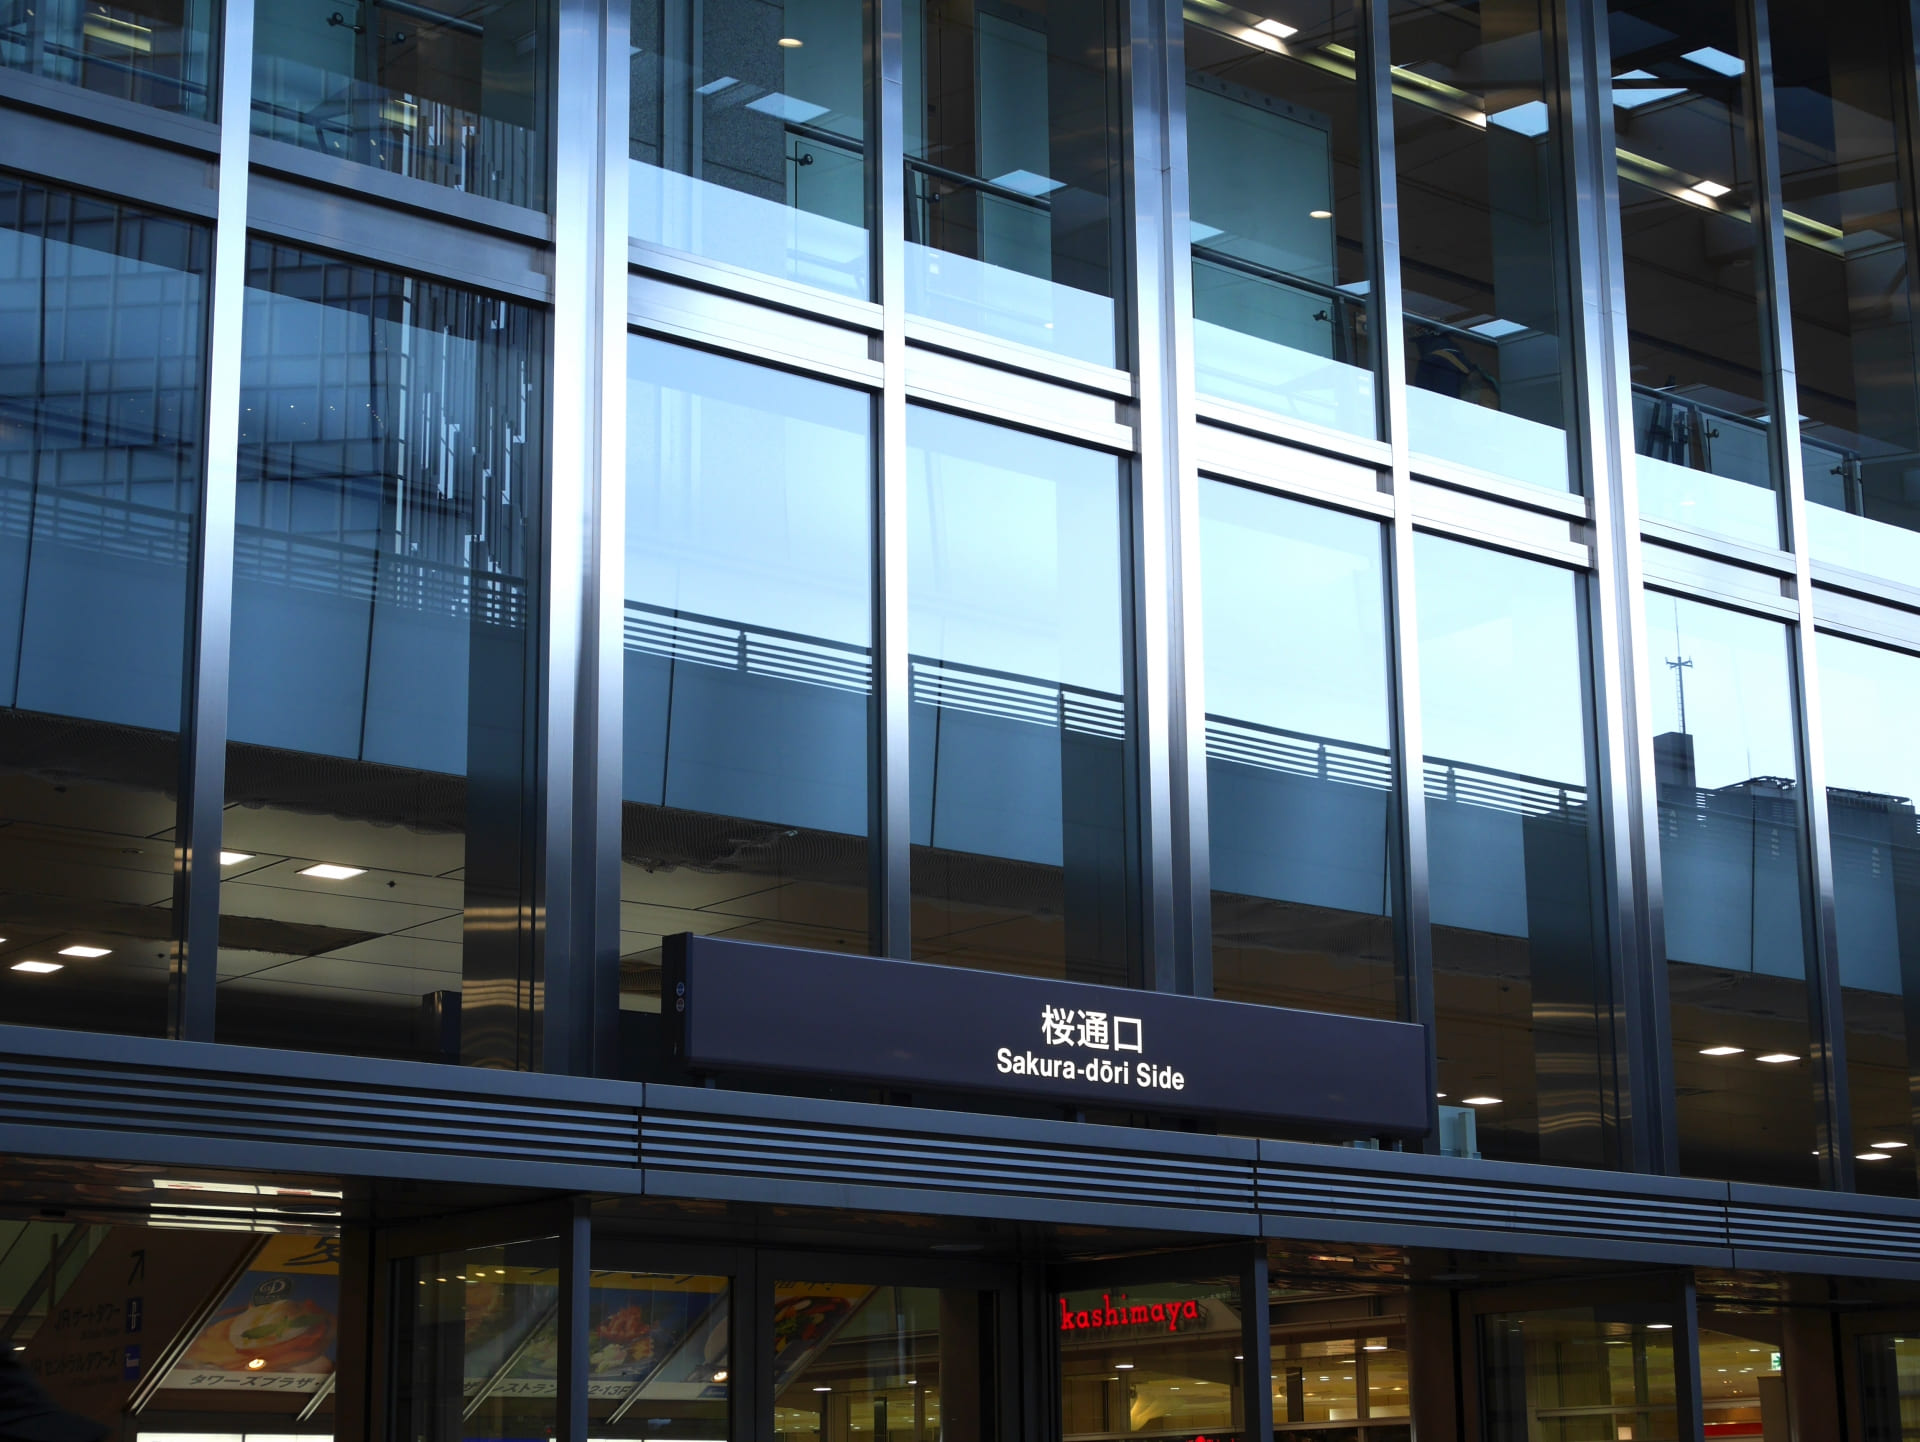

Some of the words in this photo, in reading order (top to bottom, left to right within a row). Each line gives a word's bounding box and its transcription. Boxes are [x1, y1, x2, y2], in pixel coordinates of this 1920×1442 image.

[1041, 1004, 1143, 1054] 桜通口
[997, 1048, 1129, 1085] Sakura-dōri
[1136, 1062, 1185, 1091] Side
[1059, 1293, 1199, 1332] kashimaya
